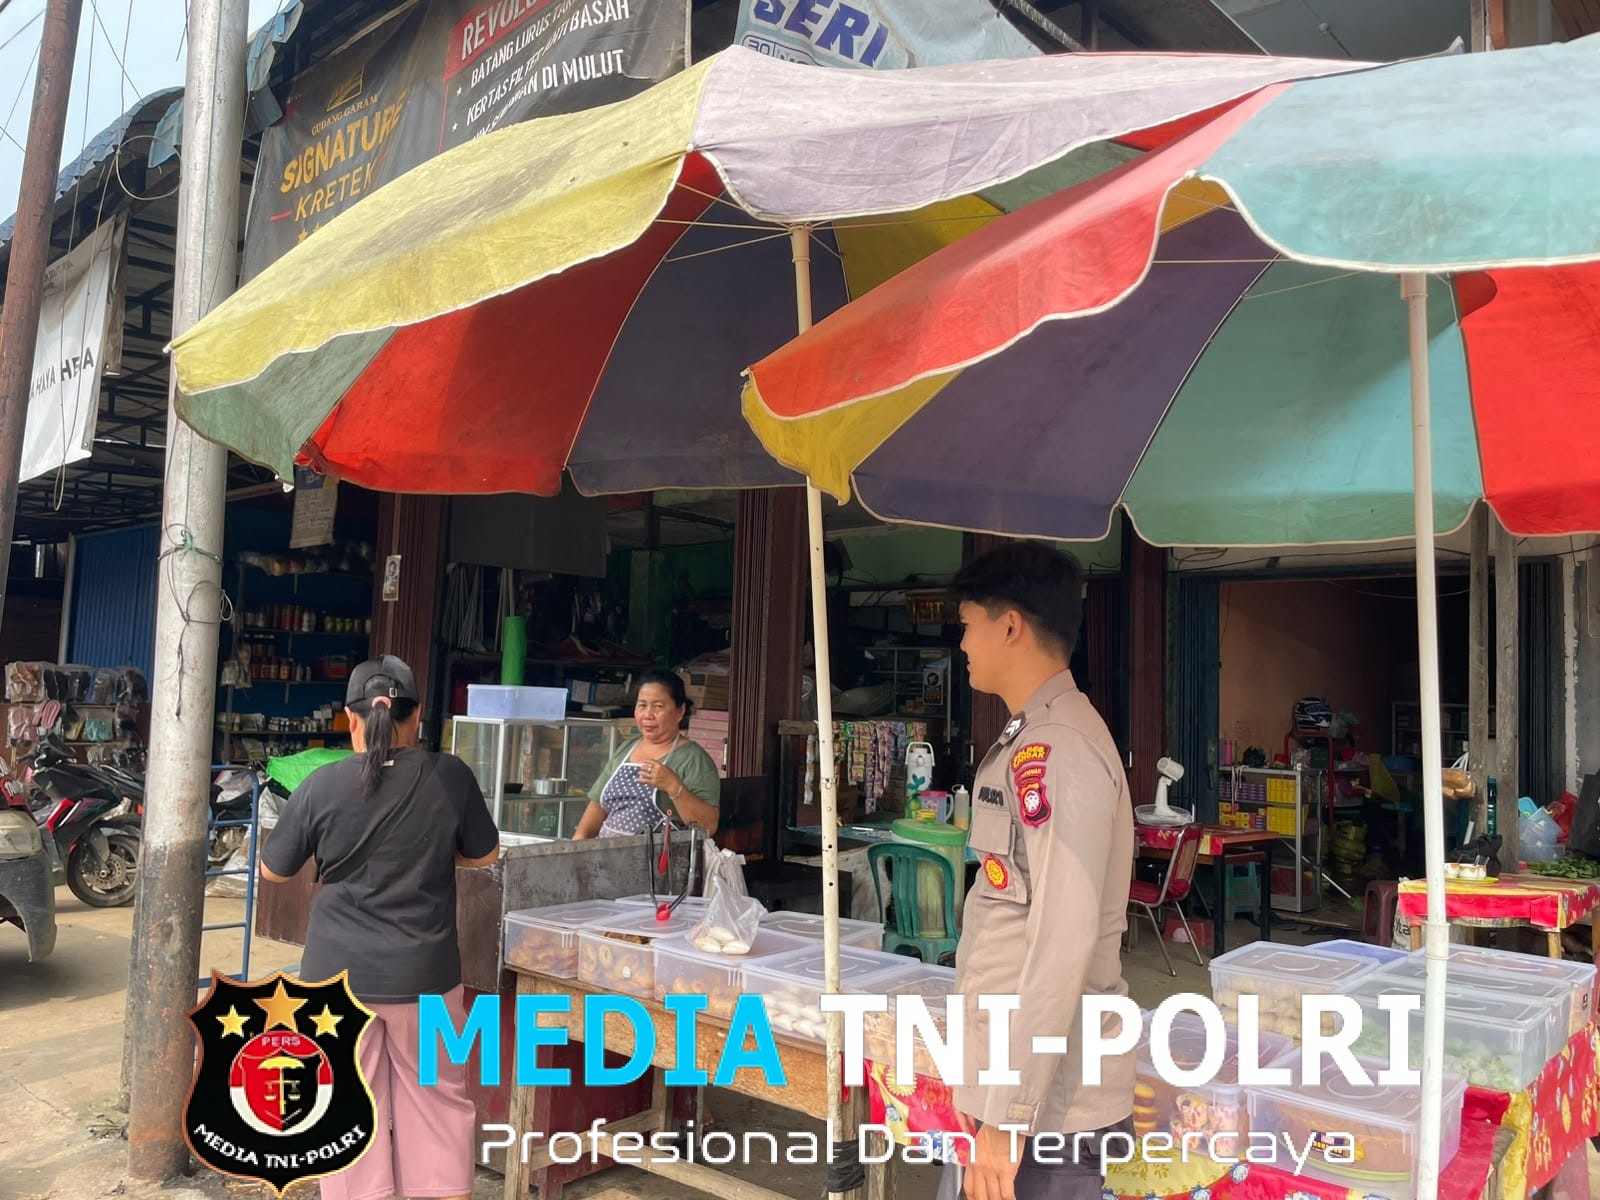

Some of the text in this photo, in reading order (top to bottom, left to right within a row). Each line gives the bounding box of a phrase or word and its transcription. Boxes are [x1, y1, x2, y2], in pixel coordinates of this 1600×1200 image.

[461, 0, 538, 60] REVOL
[471, 40, 514, 88] BATANG
[515, 13, 551, 54] LURUS
[467, 78, 509, 126] KERTAS
[569, 0, 631, 32] BASAH
[542, 49, 624, 90] DI MULUT
[280, 89, 408, 193] SIGNATURE
[311, 94, 379, 136] GUDANG GARAM
[295, 159, 378, 221] KRETEK
